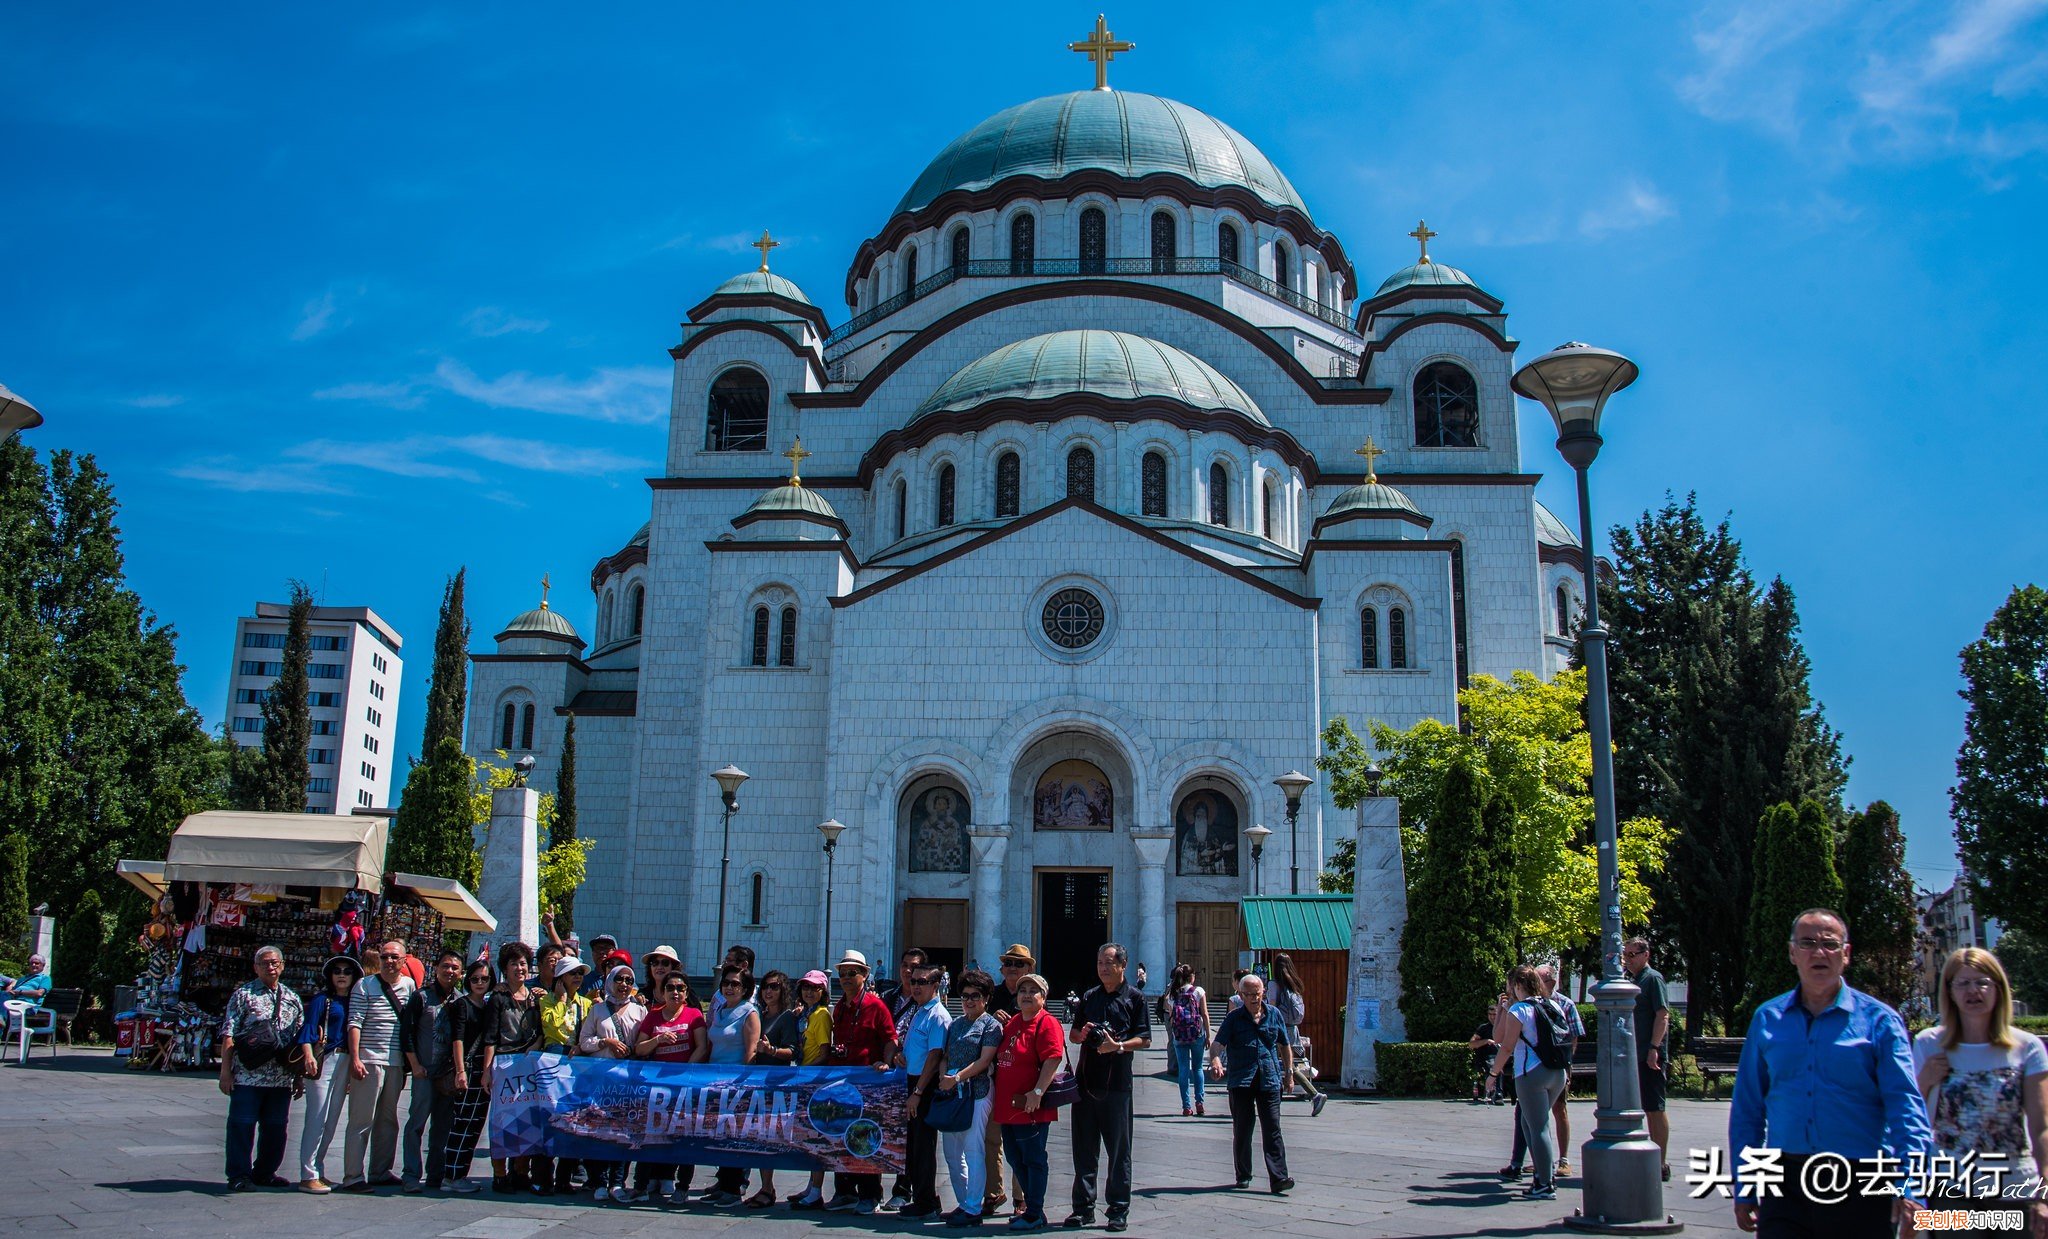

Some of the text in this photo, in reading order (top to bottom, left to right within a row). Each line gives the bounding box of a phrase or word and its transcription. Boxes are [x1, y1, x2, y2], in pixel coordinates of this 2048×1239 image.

[500, 1073, 537, 1097] ATS
[593, 1084, 647, 1096] AMAZING
[592, 1096, 646, 1108] MOMENT
[627, 1109, 644, 1120] OF
[645, 1086, 798, 1141] BALKAN
